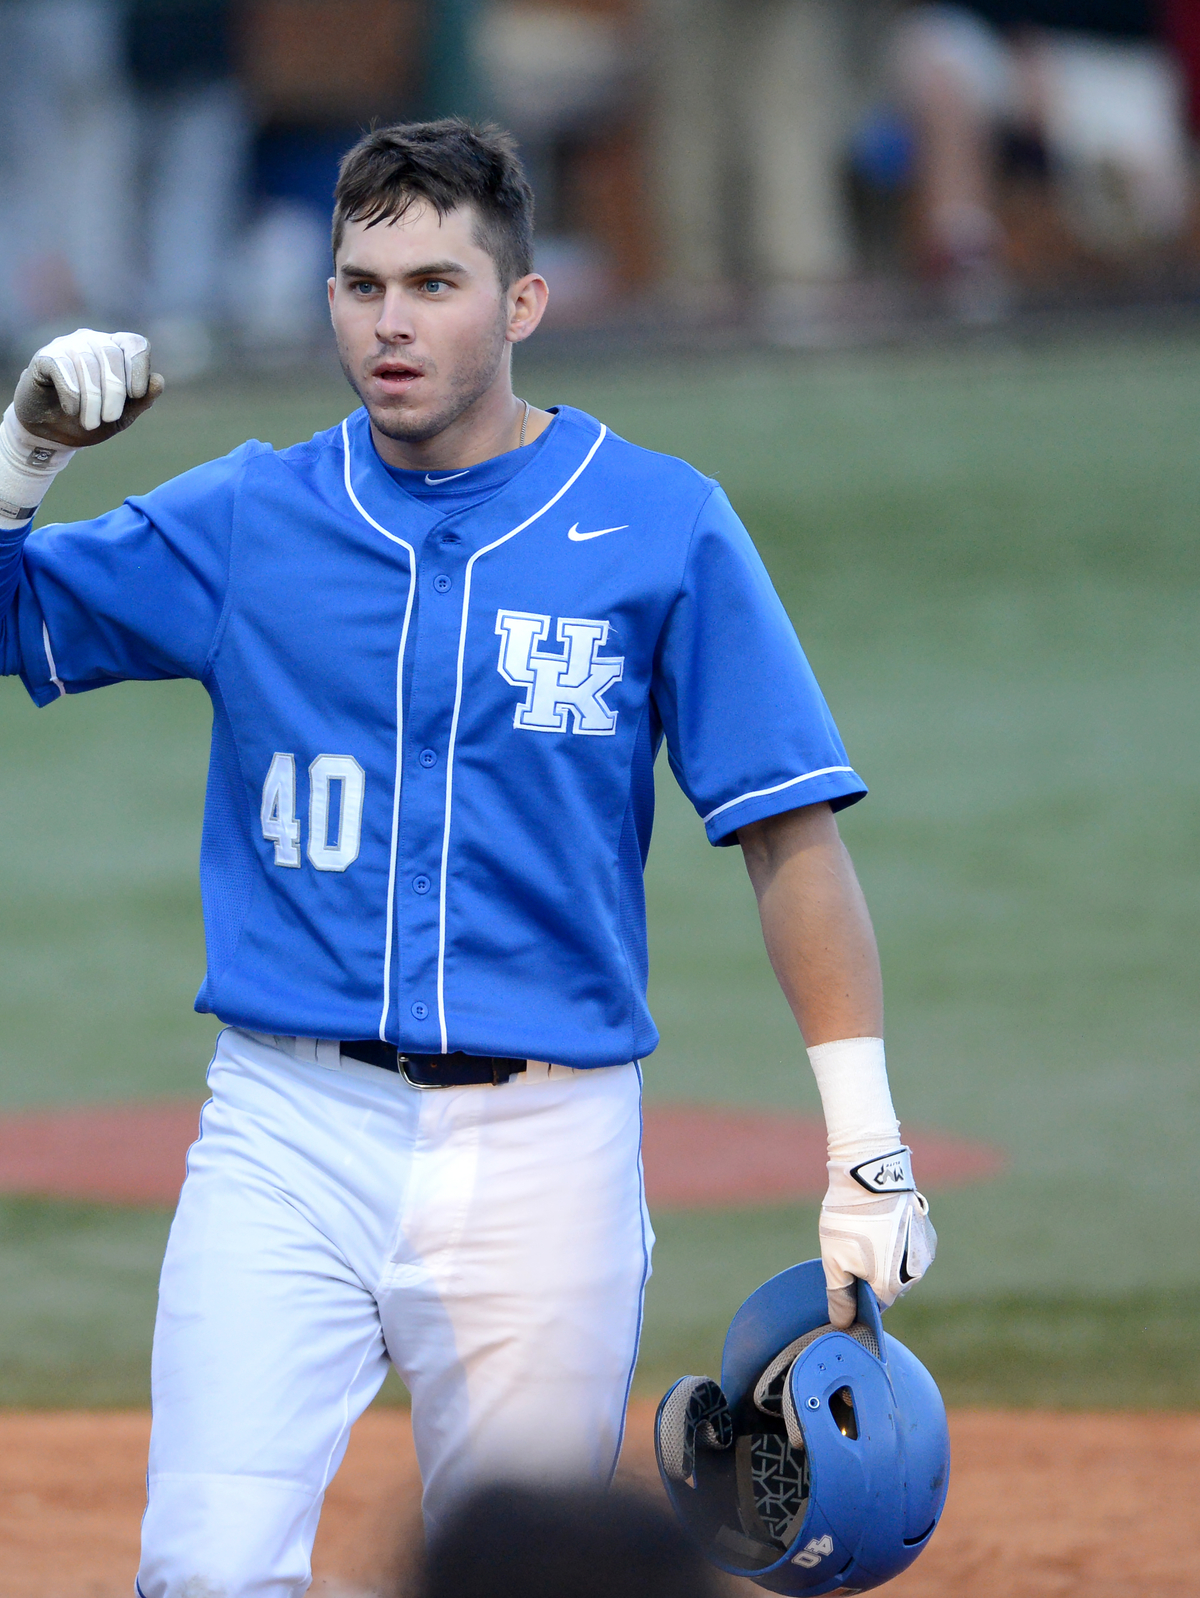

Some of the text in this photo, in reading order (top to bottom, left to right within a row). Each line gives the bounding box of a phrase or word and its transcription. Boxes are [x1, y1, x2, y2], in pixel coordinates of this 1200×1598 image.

[494, 609, 625, 736] UK
[260, 752, 365, 872] 40
[873, 1163, 904, 1186] MVP
[790, 1534, 834, 1569] 40
